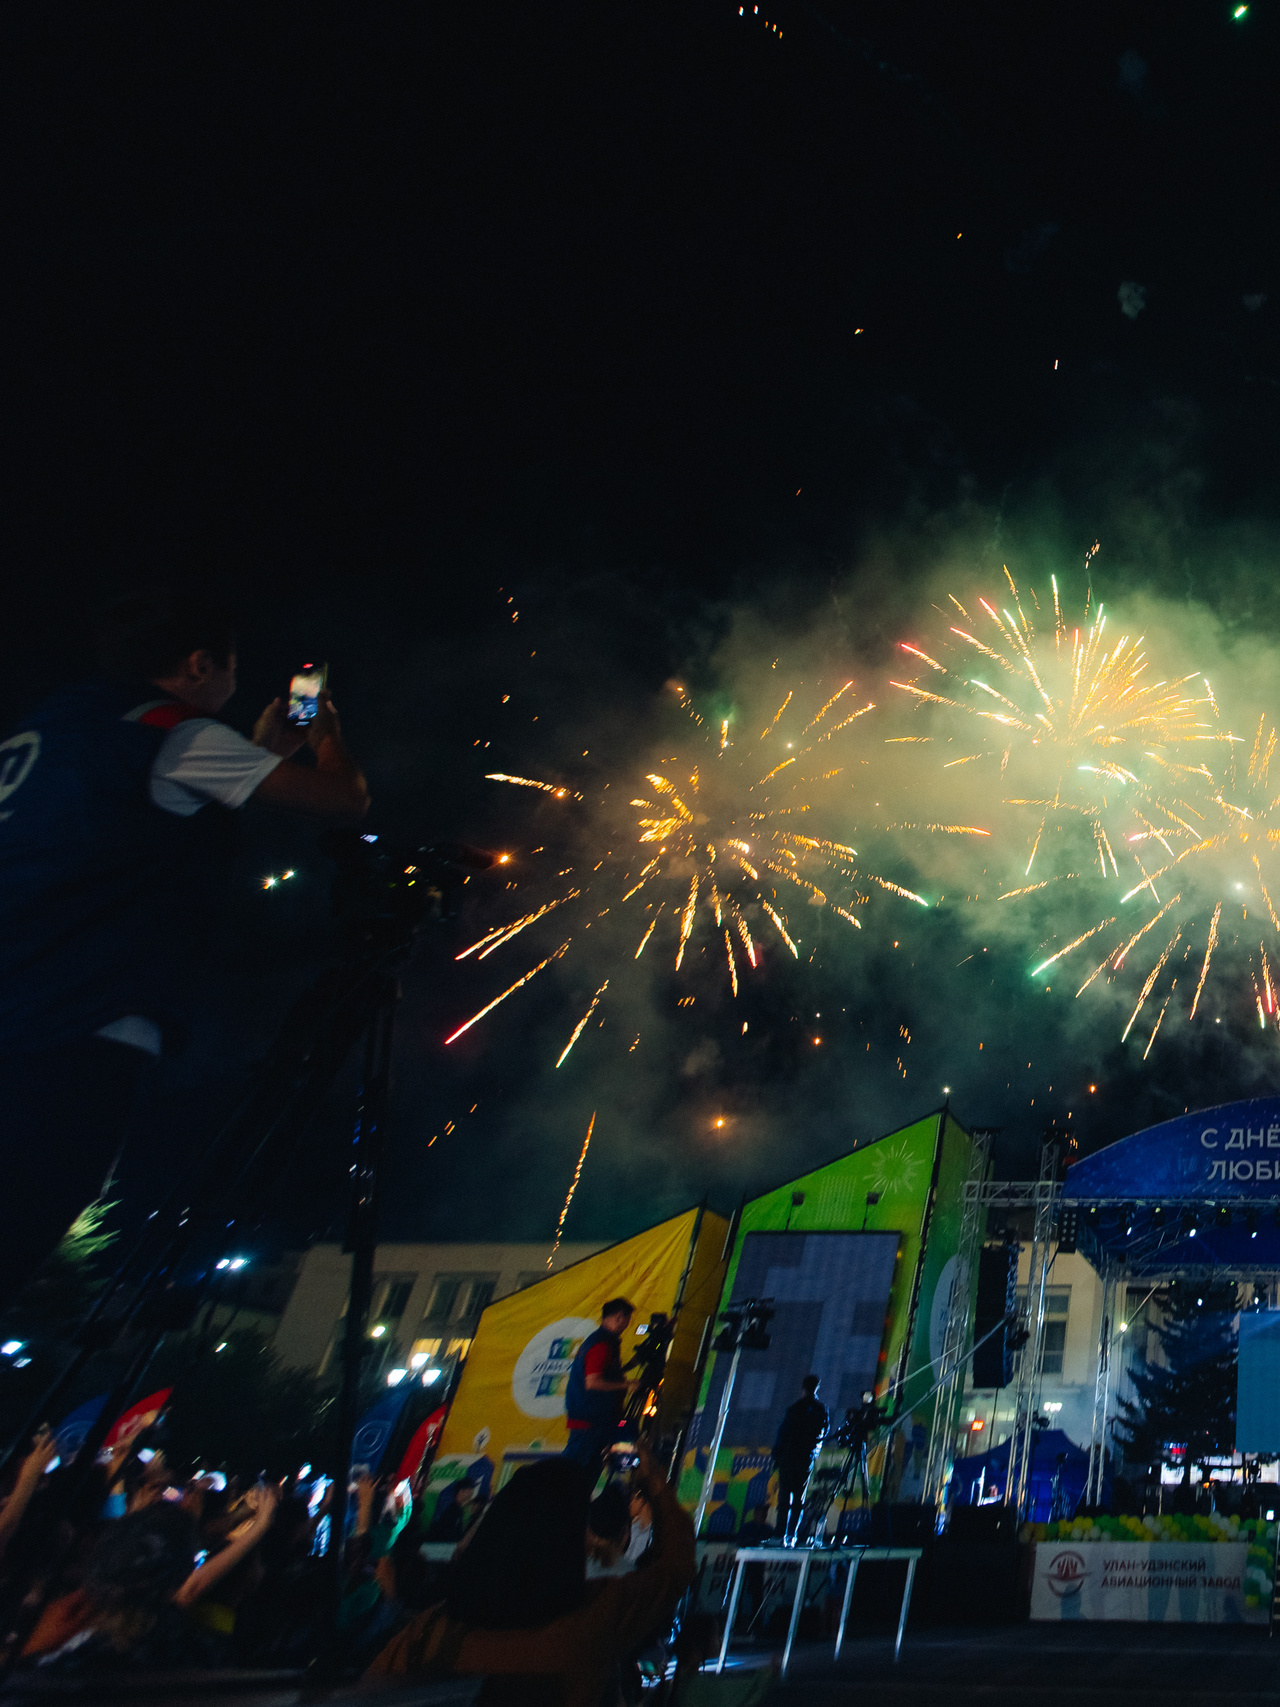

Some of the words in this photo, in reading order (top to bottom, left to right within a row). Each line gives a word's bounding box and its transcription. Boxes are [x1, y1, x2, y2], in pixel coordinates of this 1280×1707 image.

[1200, 1128, 1219, 1149] С
[1103, 1557, 1206, 1572] УЛАН-УДЭНСКИЙ
[1101, 1576, 1198, 1589] АВИАЦИОННЫЙ
[1201, 1576, 1241, 1590] ЗАВОД
